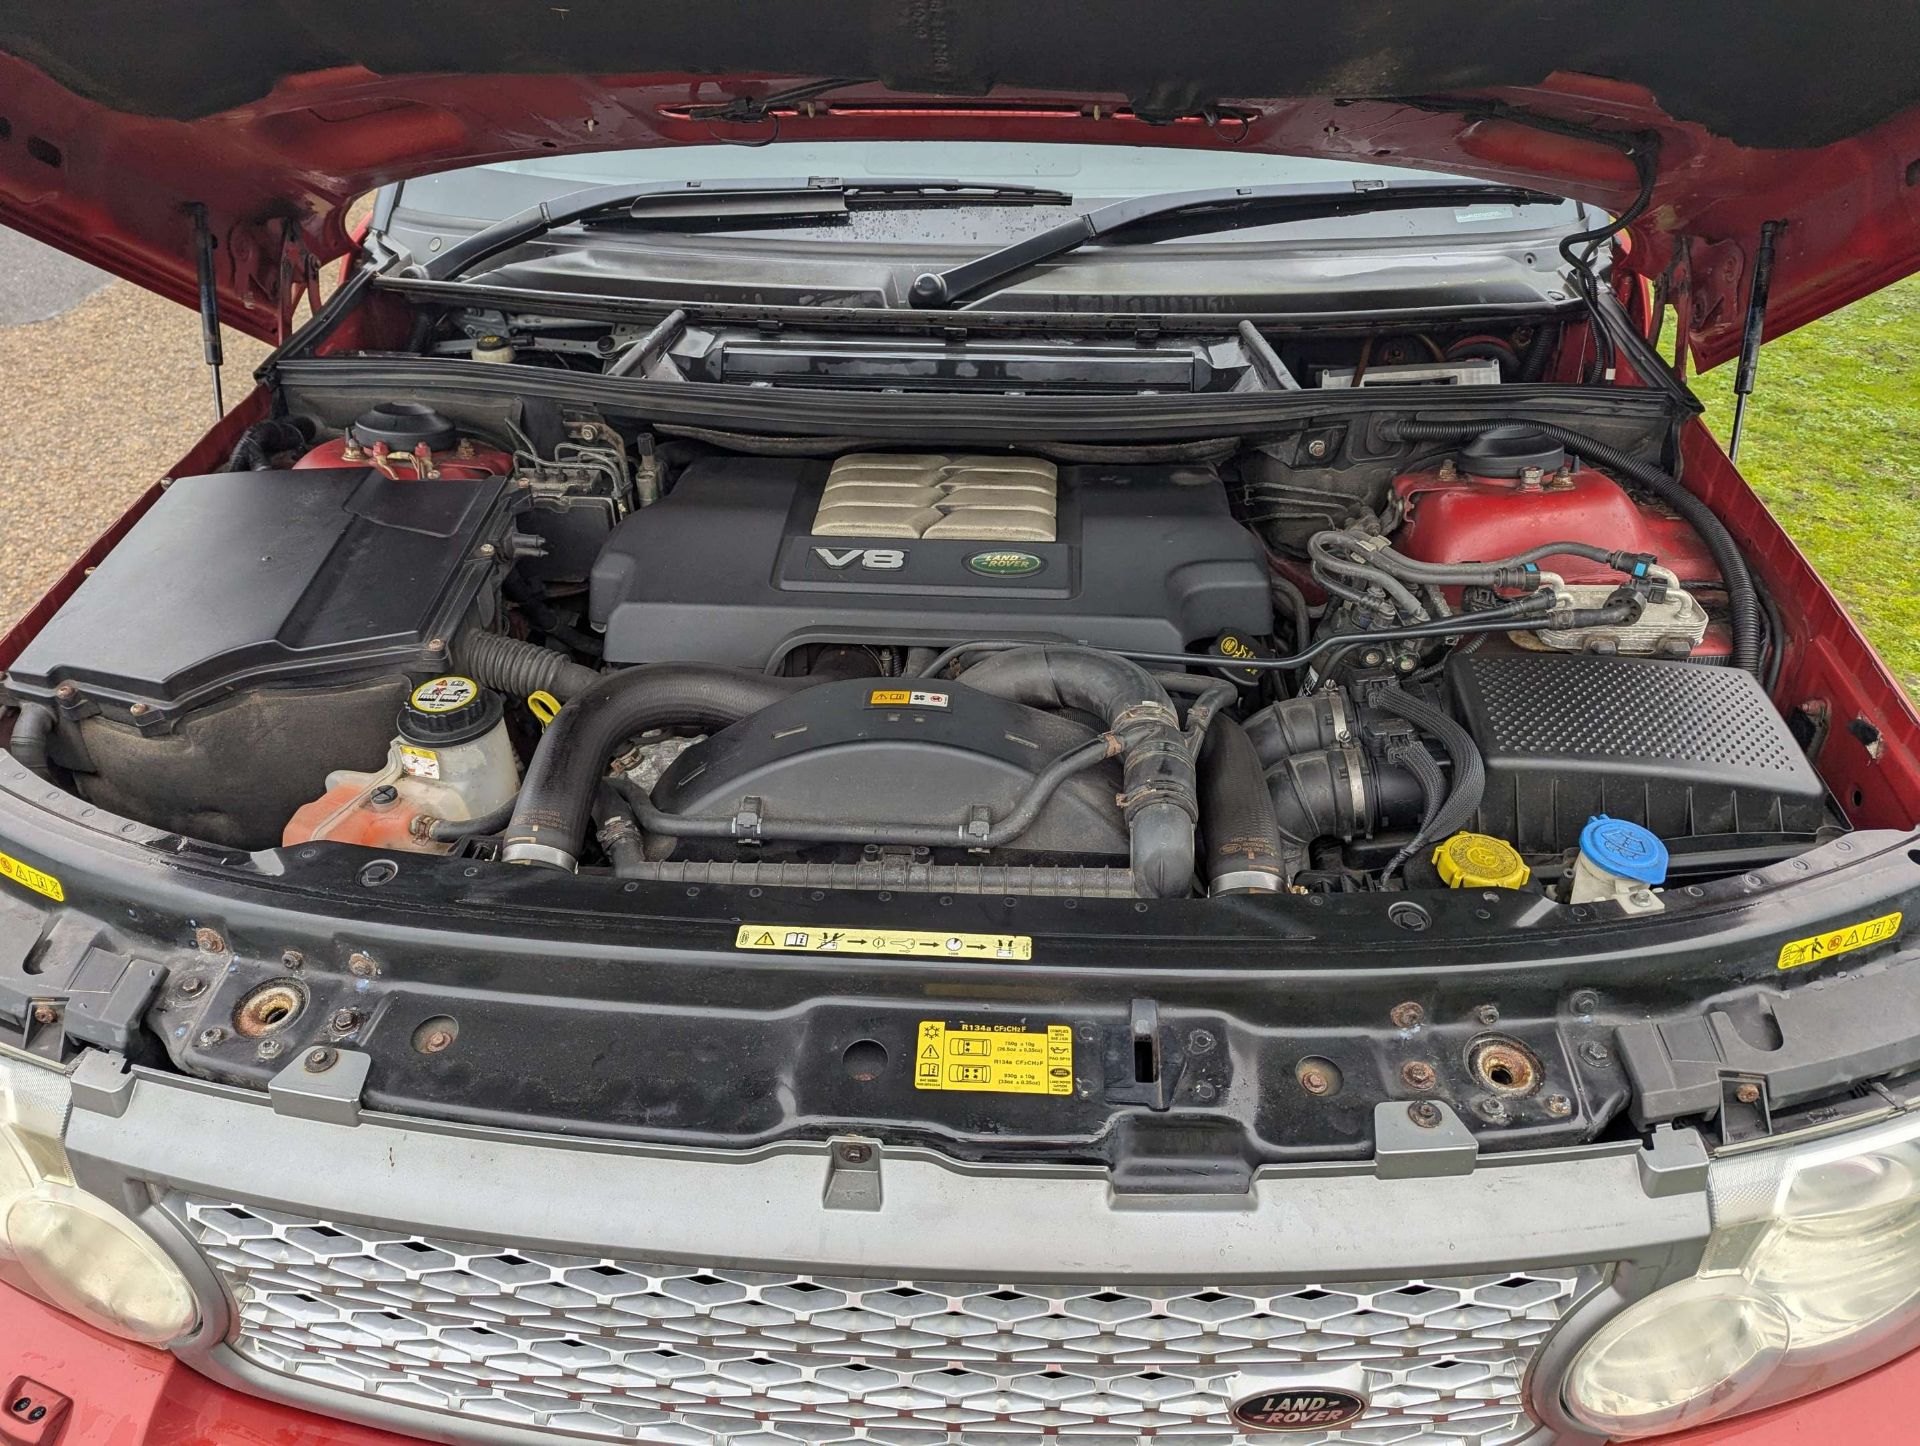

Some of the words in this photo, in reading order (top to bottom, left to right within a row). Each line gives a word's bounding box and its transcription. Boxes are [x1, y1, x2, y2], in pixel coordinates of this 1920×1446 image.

[815, 549, 904, 568] V8
[962, 1024, 992, 1032] R134a
[1262, 1397, 1326, 1412] LAND
[1266, 1409, 1344, 1423] ROVER
